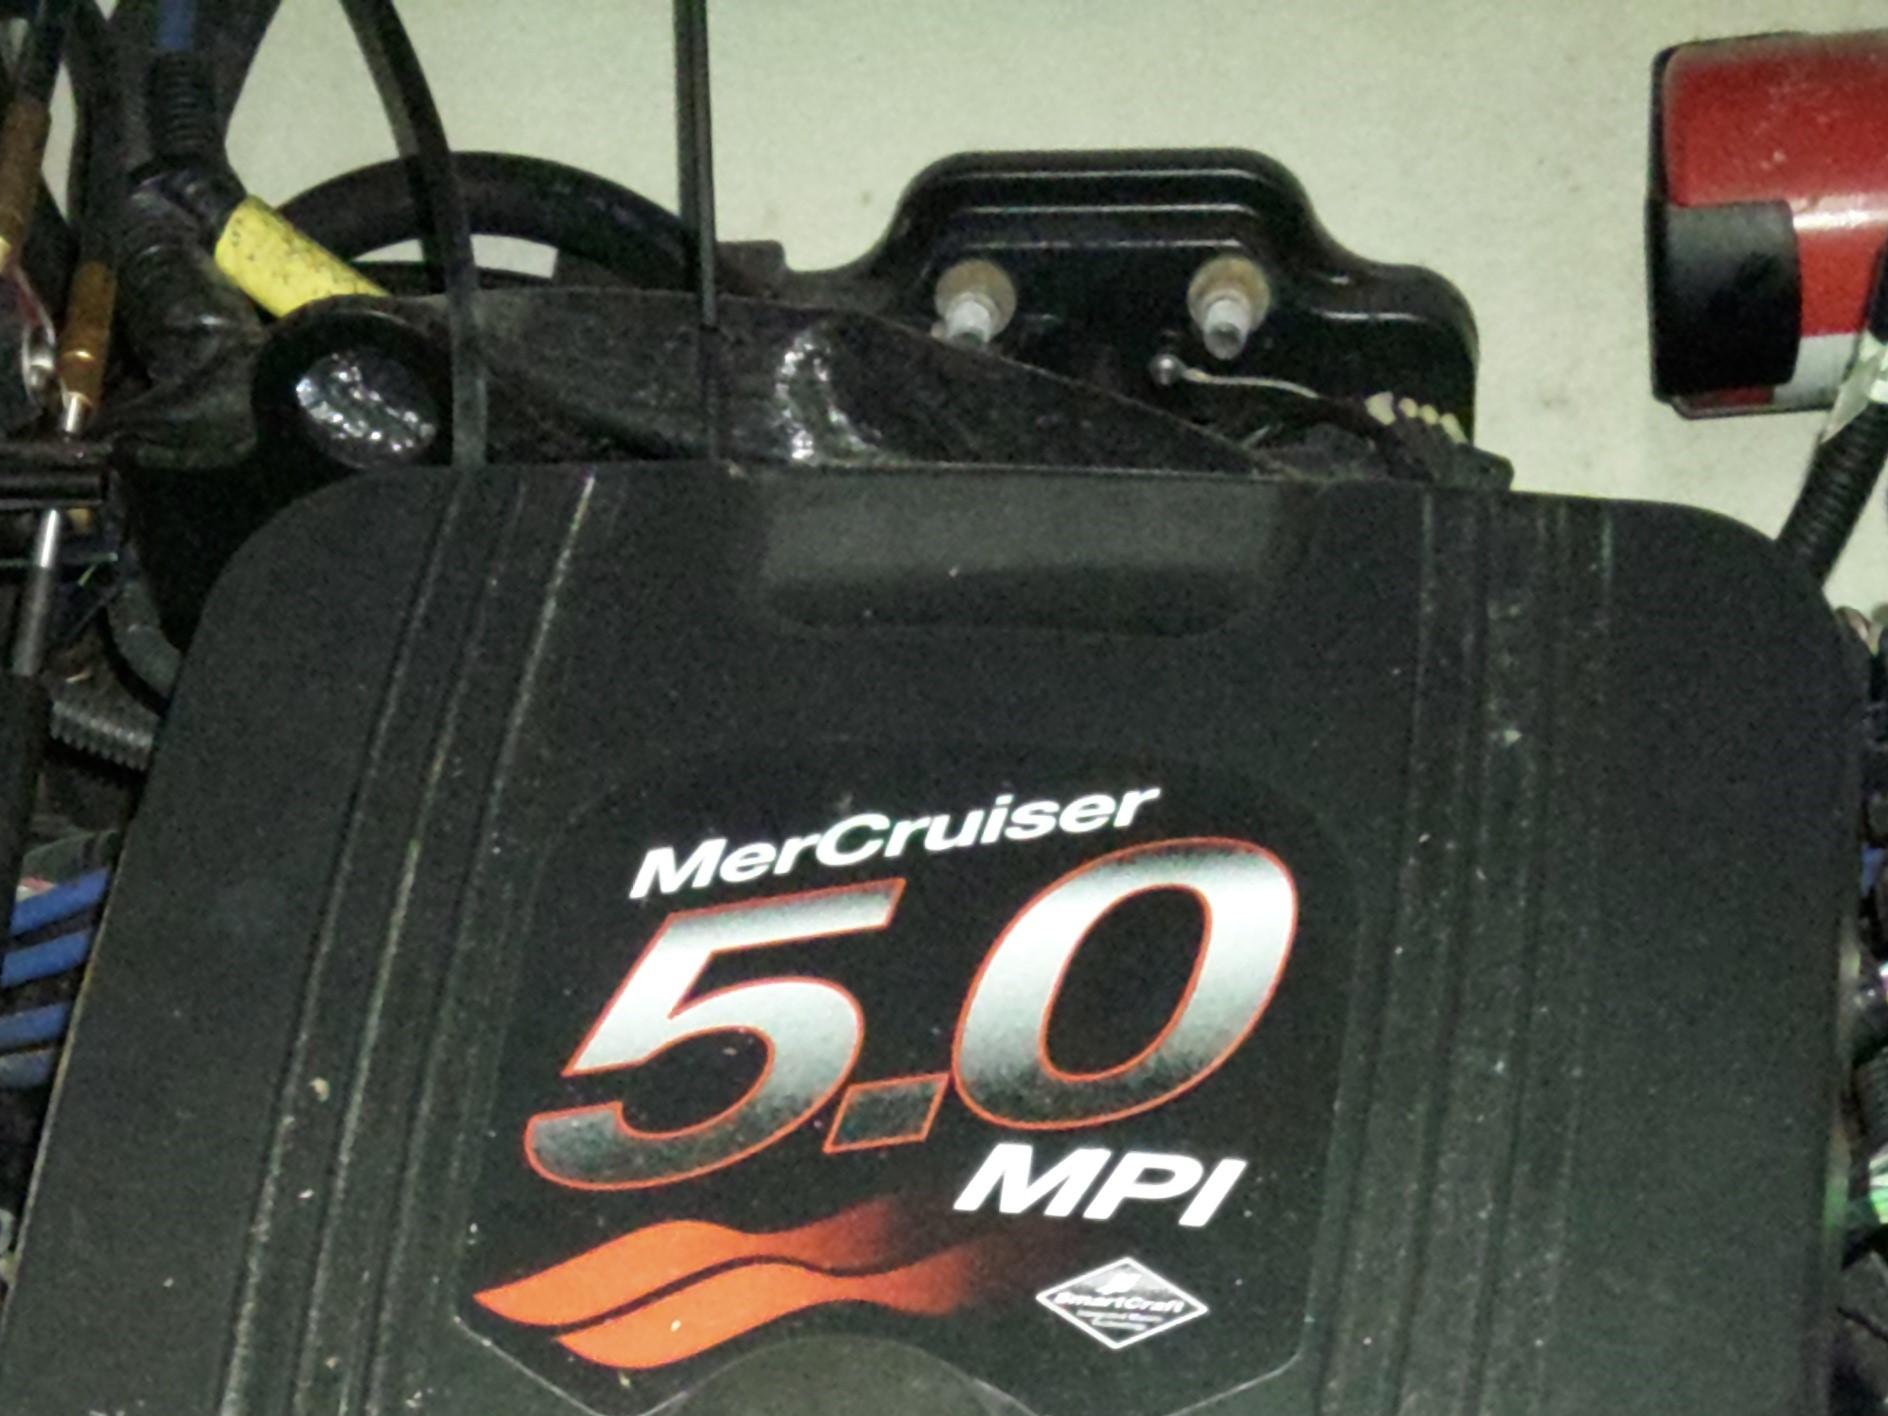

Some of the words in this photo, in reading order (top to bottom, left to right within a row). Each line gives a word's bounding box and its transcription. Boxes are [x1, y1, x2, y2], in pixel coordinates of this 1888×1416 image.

[628, 786, 1162, 901] MerCruiser
[524, 837, 1299, 1191] 5.0
[953, 1143, 1248, 1228] MPI
